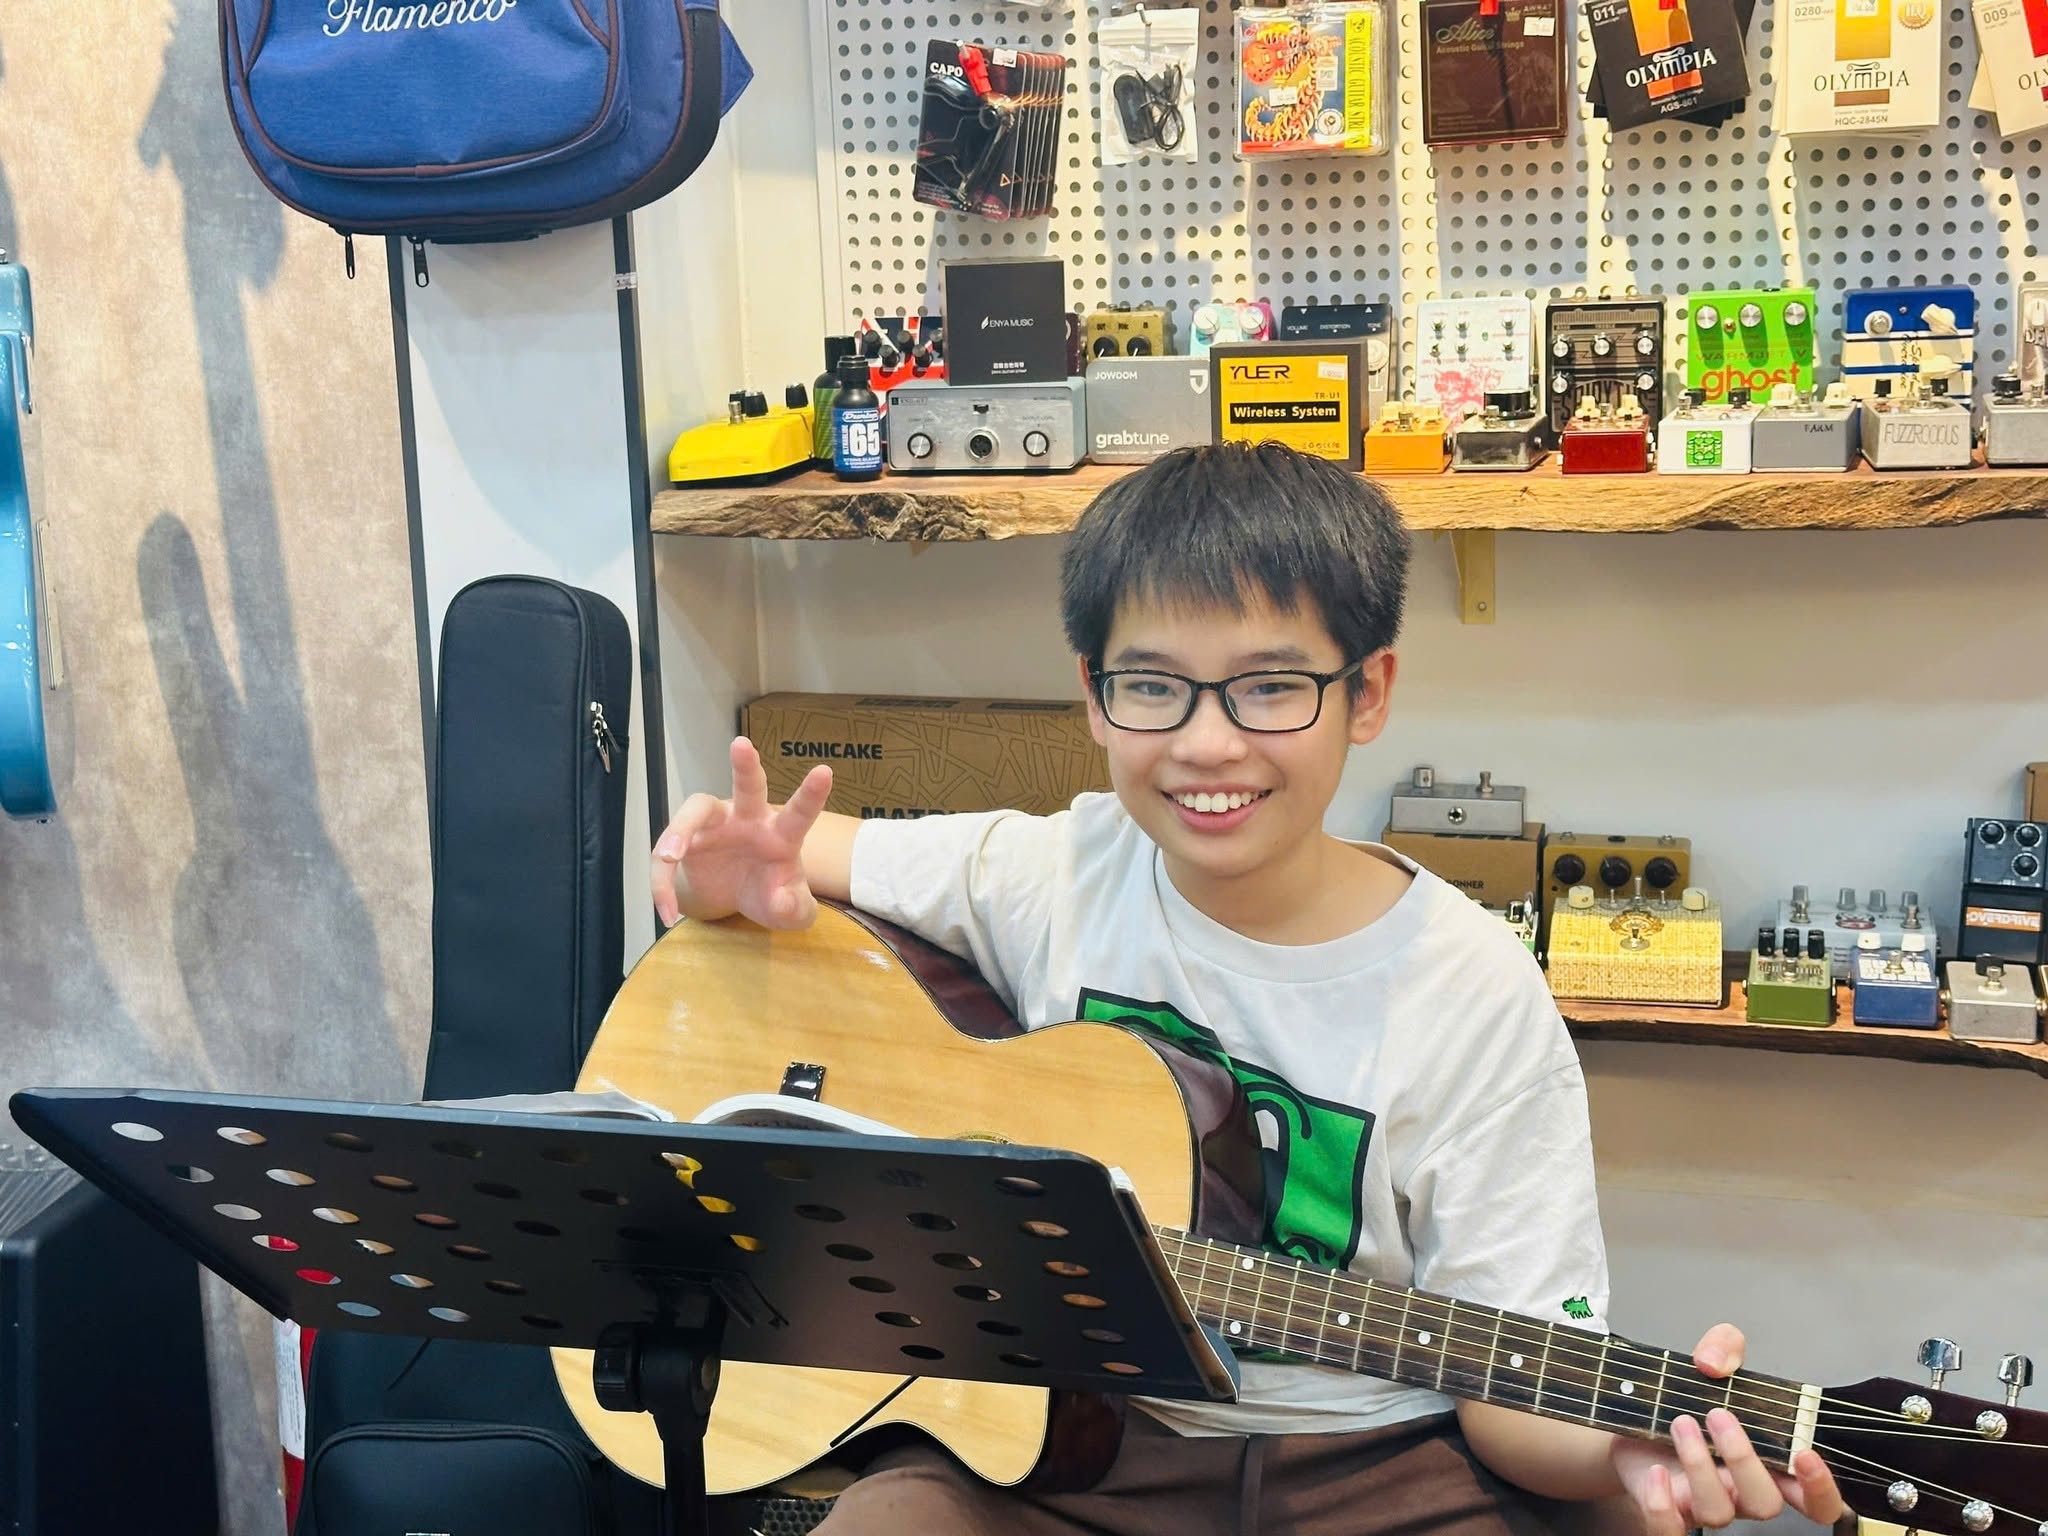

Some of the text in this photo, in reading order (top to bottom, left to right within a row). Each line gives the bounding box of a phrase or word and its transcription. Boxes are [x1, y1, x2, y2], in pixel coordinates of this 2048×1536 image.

[323, 0, 516, 37] Flamenco
[1435, 17, 1495, 43] Alice
[929, 62, 964, 77] CAPO
[1626, 47, 1718, 88] OLYMPIA
[1814, 70, 1910, 91] OLYMPIA
[989, 318, 1034, 328] ENYA MUSIC
[1095, 371, 1138, 381] JOWOOM
[1701, 361, 1800, 400] ghost
[1314, 392, 1341, 400] TR-U1
[1234, 406, 1337, 419] Wireless System
[849, 423, 880, 457] 65
[1096, 430, 1170, 448] grabtune
[780, 741, 883, 760] SONICAKE
